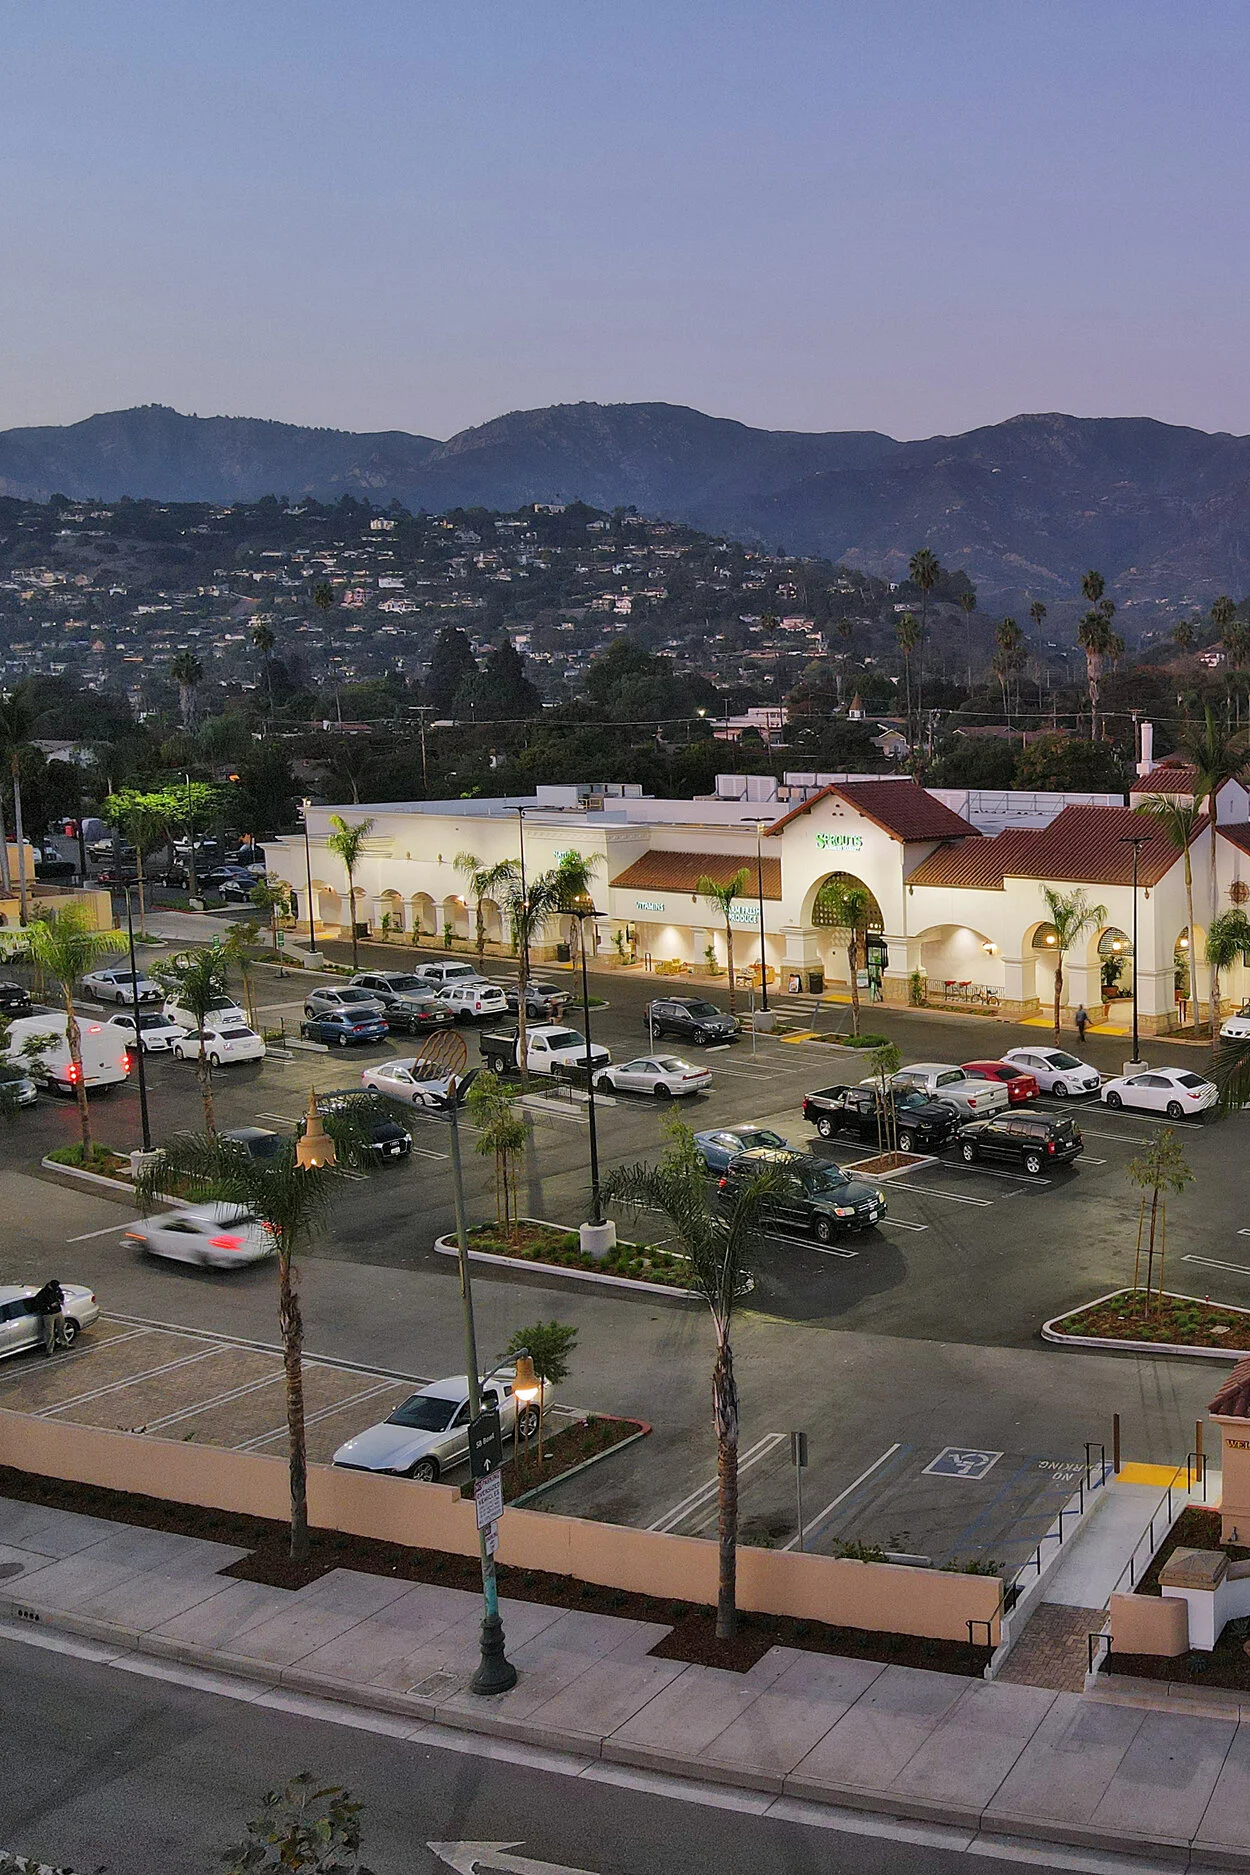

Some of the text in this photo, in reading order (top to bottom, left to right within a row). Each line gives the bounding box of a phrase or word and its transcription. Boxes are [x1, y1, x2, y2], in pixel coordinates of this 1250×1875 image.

[815, 832, 864, 849] SPROUTS
[635, 901, 665, 912] VITAMINS
[728, 913, 758, 924] PRODUCE
[1052, 1472, 1074, 1481] NO
